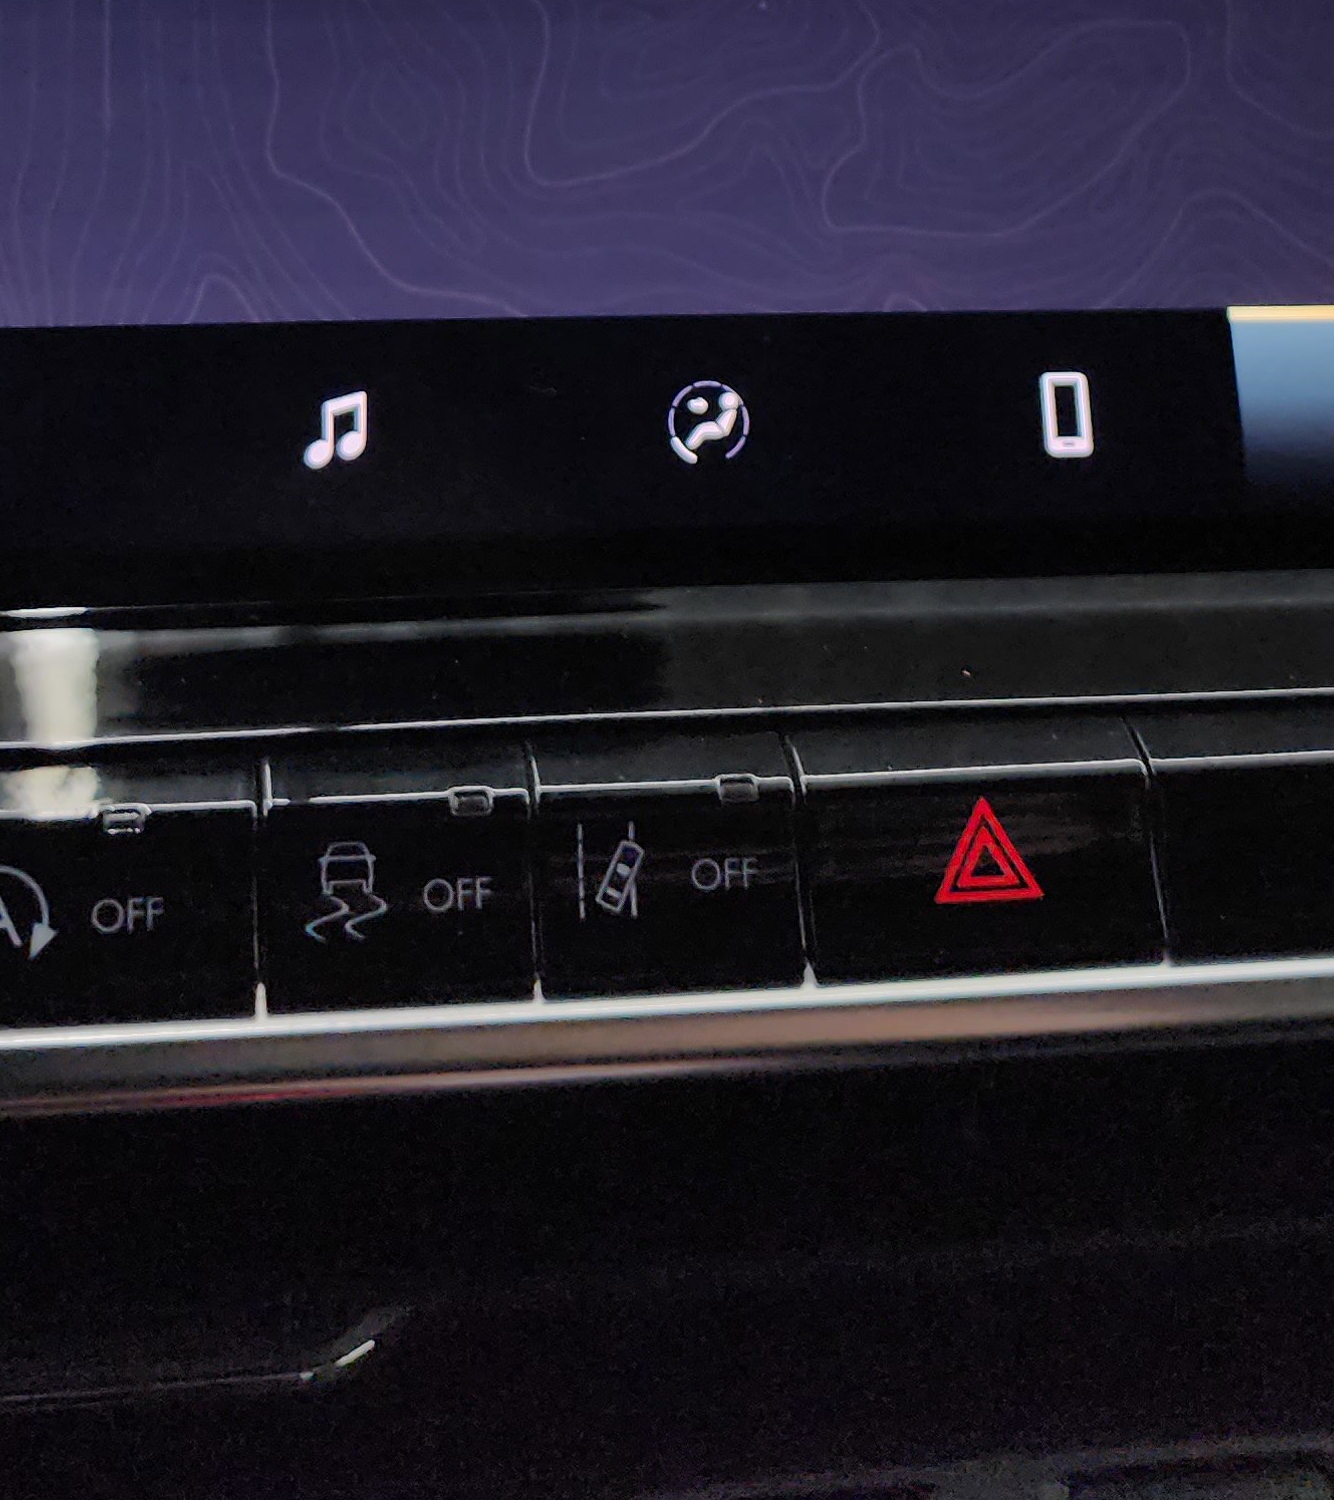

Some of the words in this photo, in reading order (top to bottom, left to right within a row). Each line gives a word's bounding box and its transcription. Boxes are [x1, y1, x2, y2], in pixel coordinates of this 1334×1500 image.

[690, 857, 760, 892] OFF
[423, 877, 494, 913] OFF
[91, 897, 165, 933] OFF
